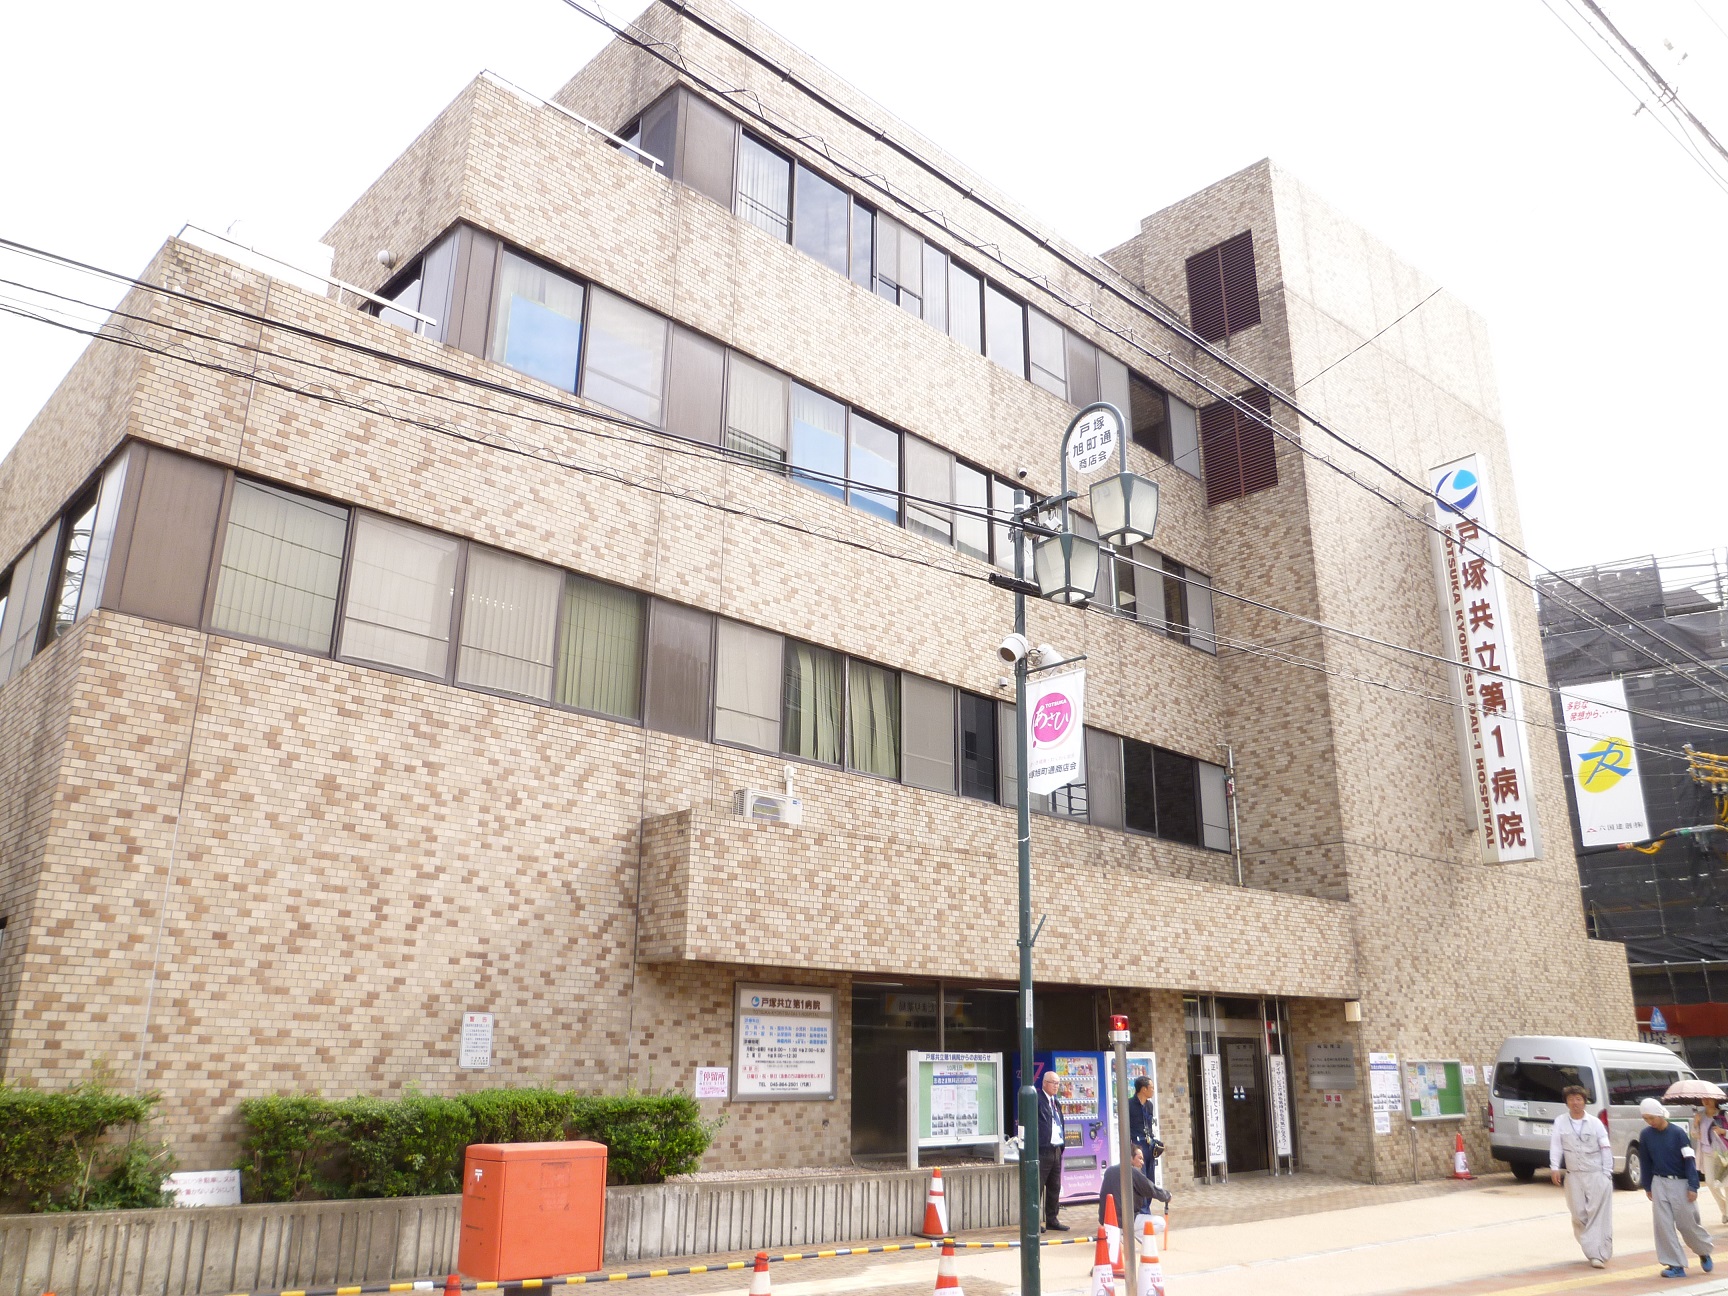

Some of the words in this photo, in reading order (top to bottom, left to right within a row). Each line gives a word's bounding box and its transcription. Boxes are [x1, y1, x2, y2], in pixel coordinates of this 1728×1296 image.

[1079, 415, 1105, 438] 戸塚
[1072, 429, 1112, 458] 旭町通
[1078, 450, 1107, 470] 商店会
[1455, 516, 1527, 850] 戸塚共立第1病院
[1045, 699, 1067, 708] TOTSUKA
[1566, 700, 1589, 712] 多彩な
[1475, 758, 1495, 849] HOSPITAL
[761, 997, 821, 1010] 戸塚共立第1病院
